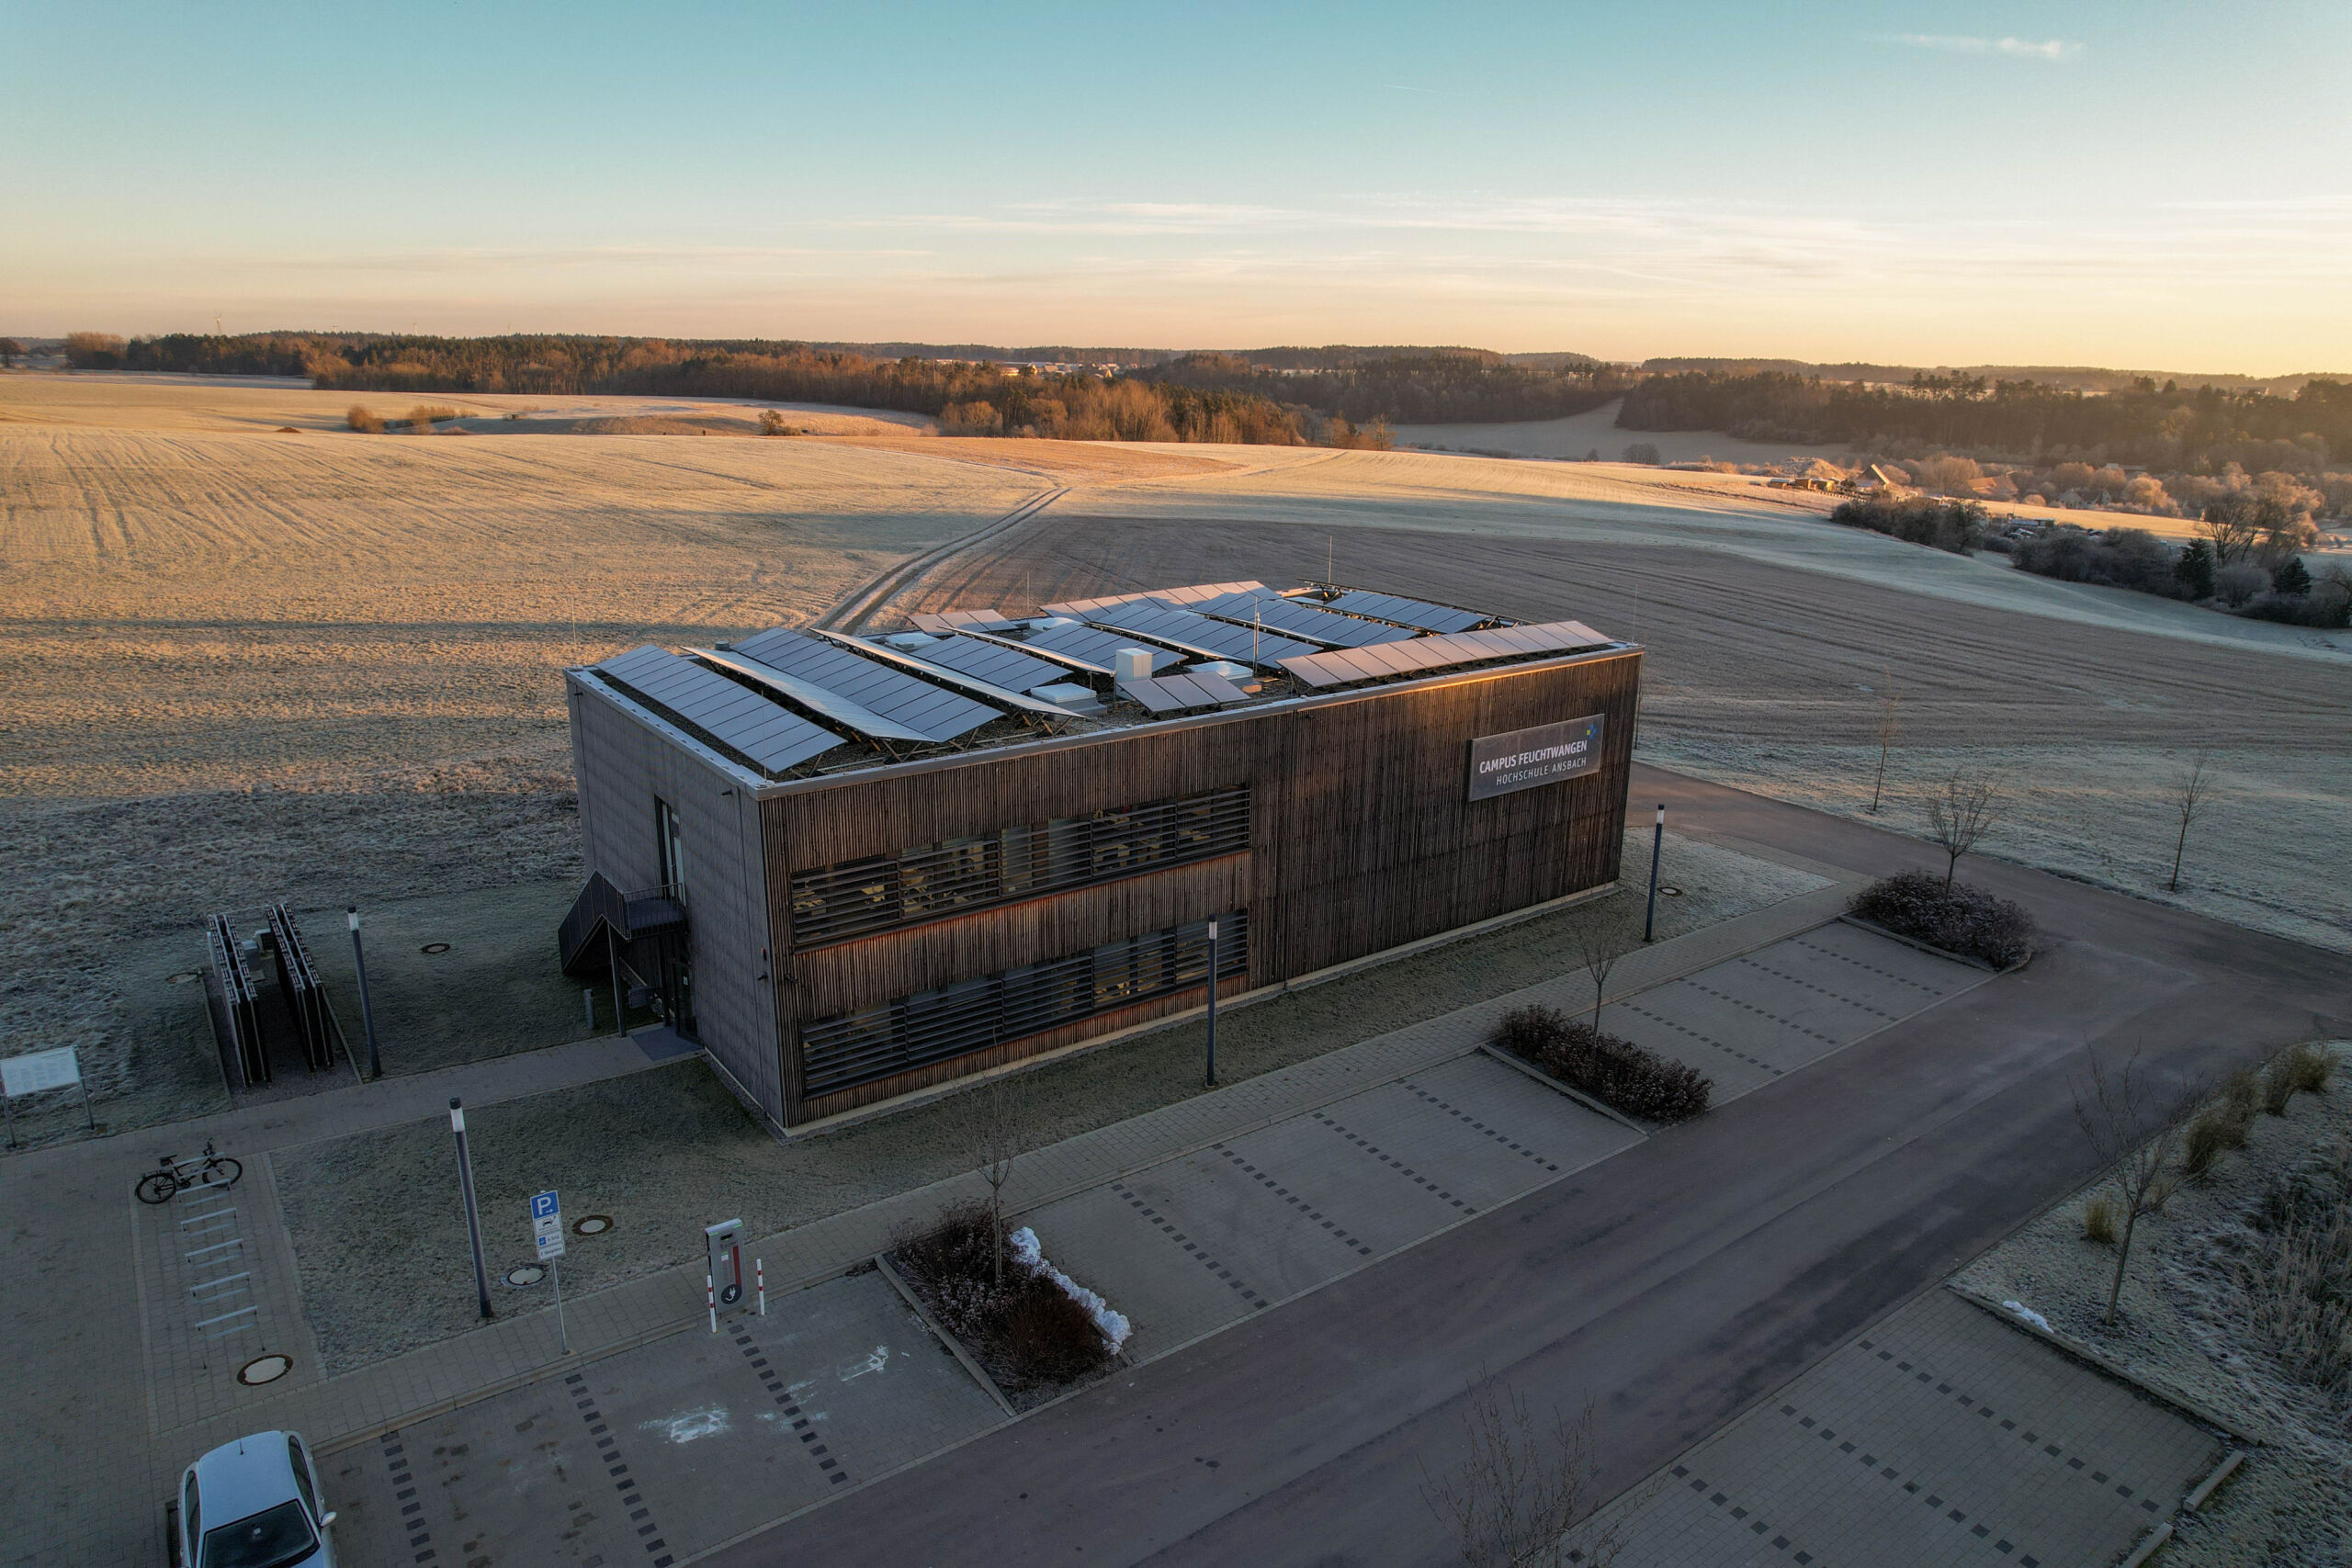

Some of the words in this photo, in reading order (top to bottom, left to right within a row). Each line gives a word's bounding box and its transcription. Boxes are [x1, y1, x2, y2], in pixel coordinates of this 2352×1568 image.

[1480, 756, 1516, 773] CAMPUS
[1519, 740, 1588, 765] FEUCHTWANGEN
[1497, 765, 1548, 785] HOCHSCHULE
[1552, 758, 1587, 773] ANSBACH
[537, 1197, 551, 1214] P
